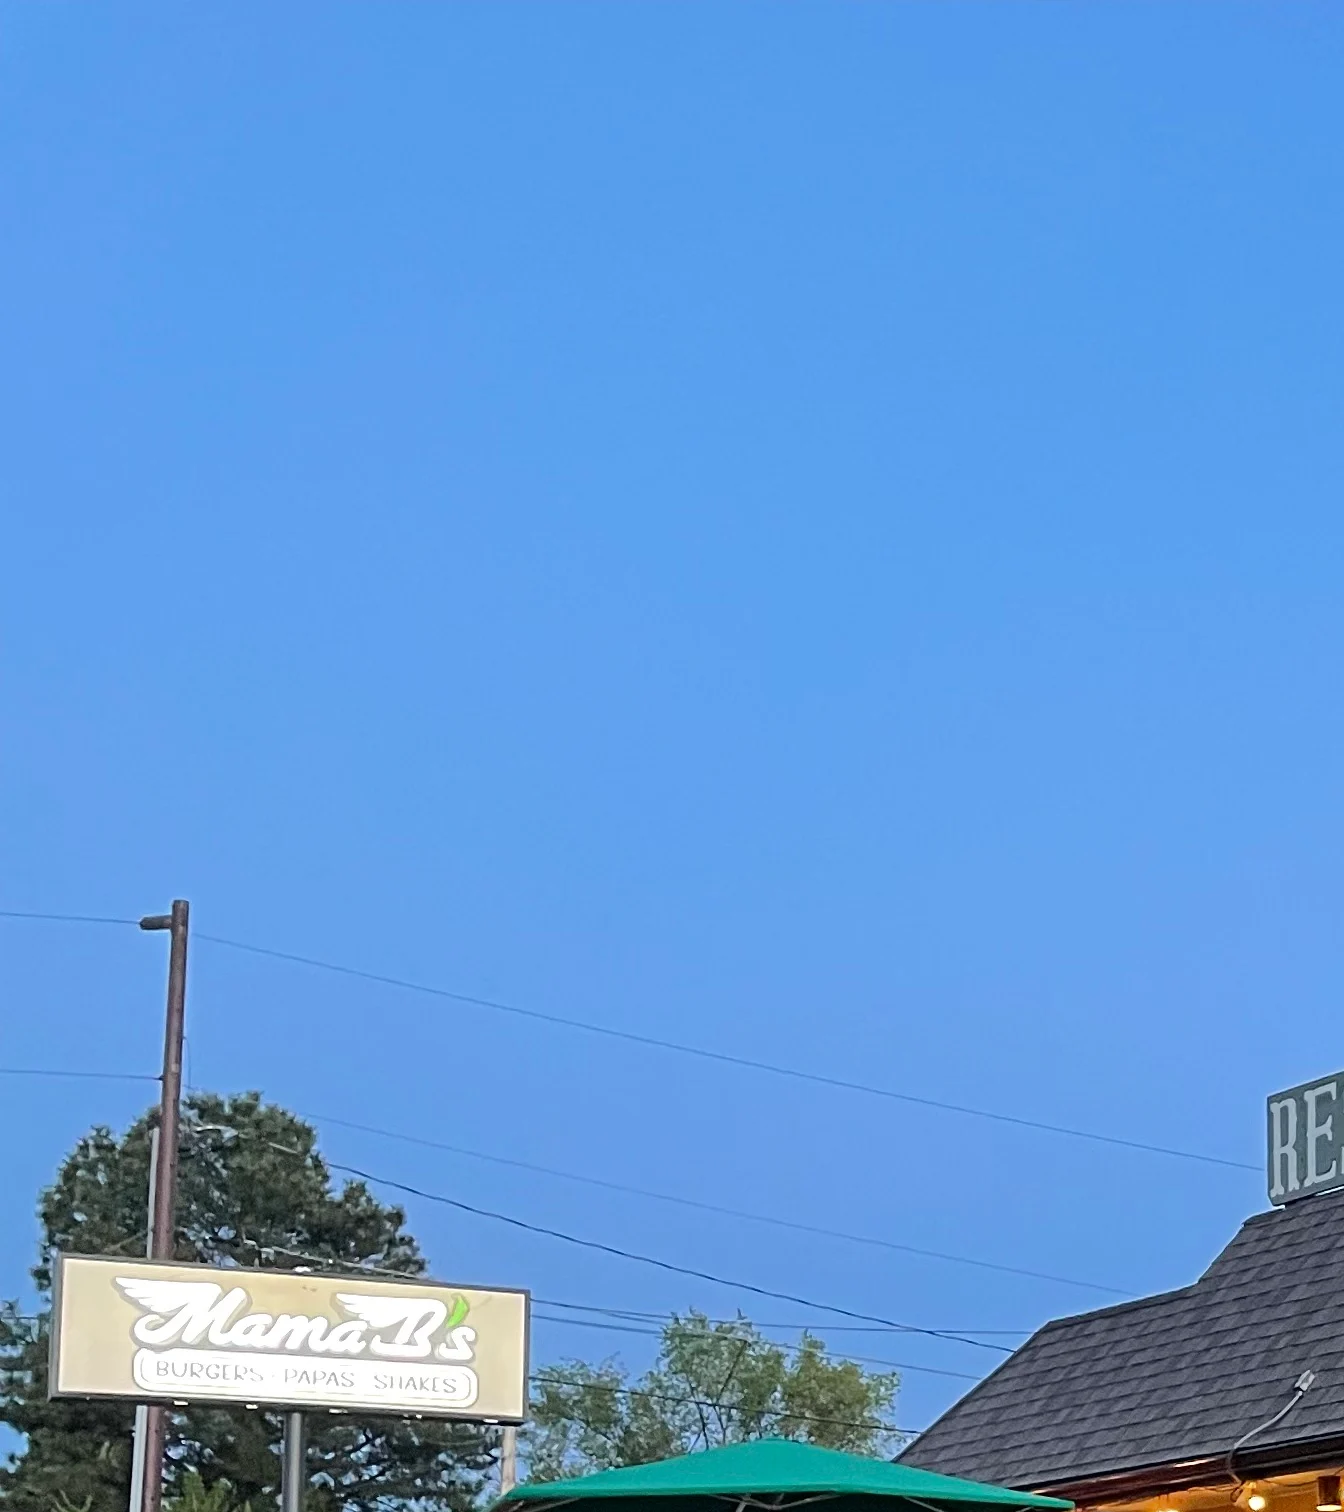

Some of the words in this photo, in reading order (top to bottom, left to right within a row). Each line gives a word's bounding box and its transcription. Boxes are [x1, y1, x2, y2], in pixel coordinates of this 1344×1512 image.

[120, 1279, 368, 1353] Mama
[343, 1291, 478, 1361] B's
[155, 1359, 264, 1382] BURGERS
[284, 1367, 355, 1388] PAPAS
[374, 1372, 458, 1394] SHAKES
